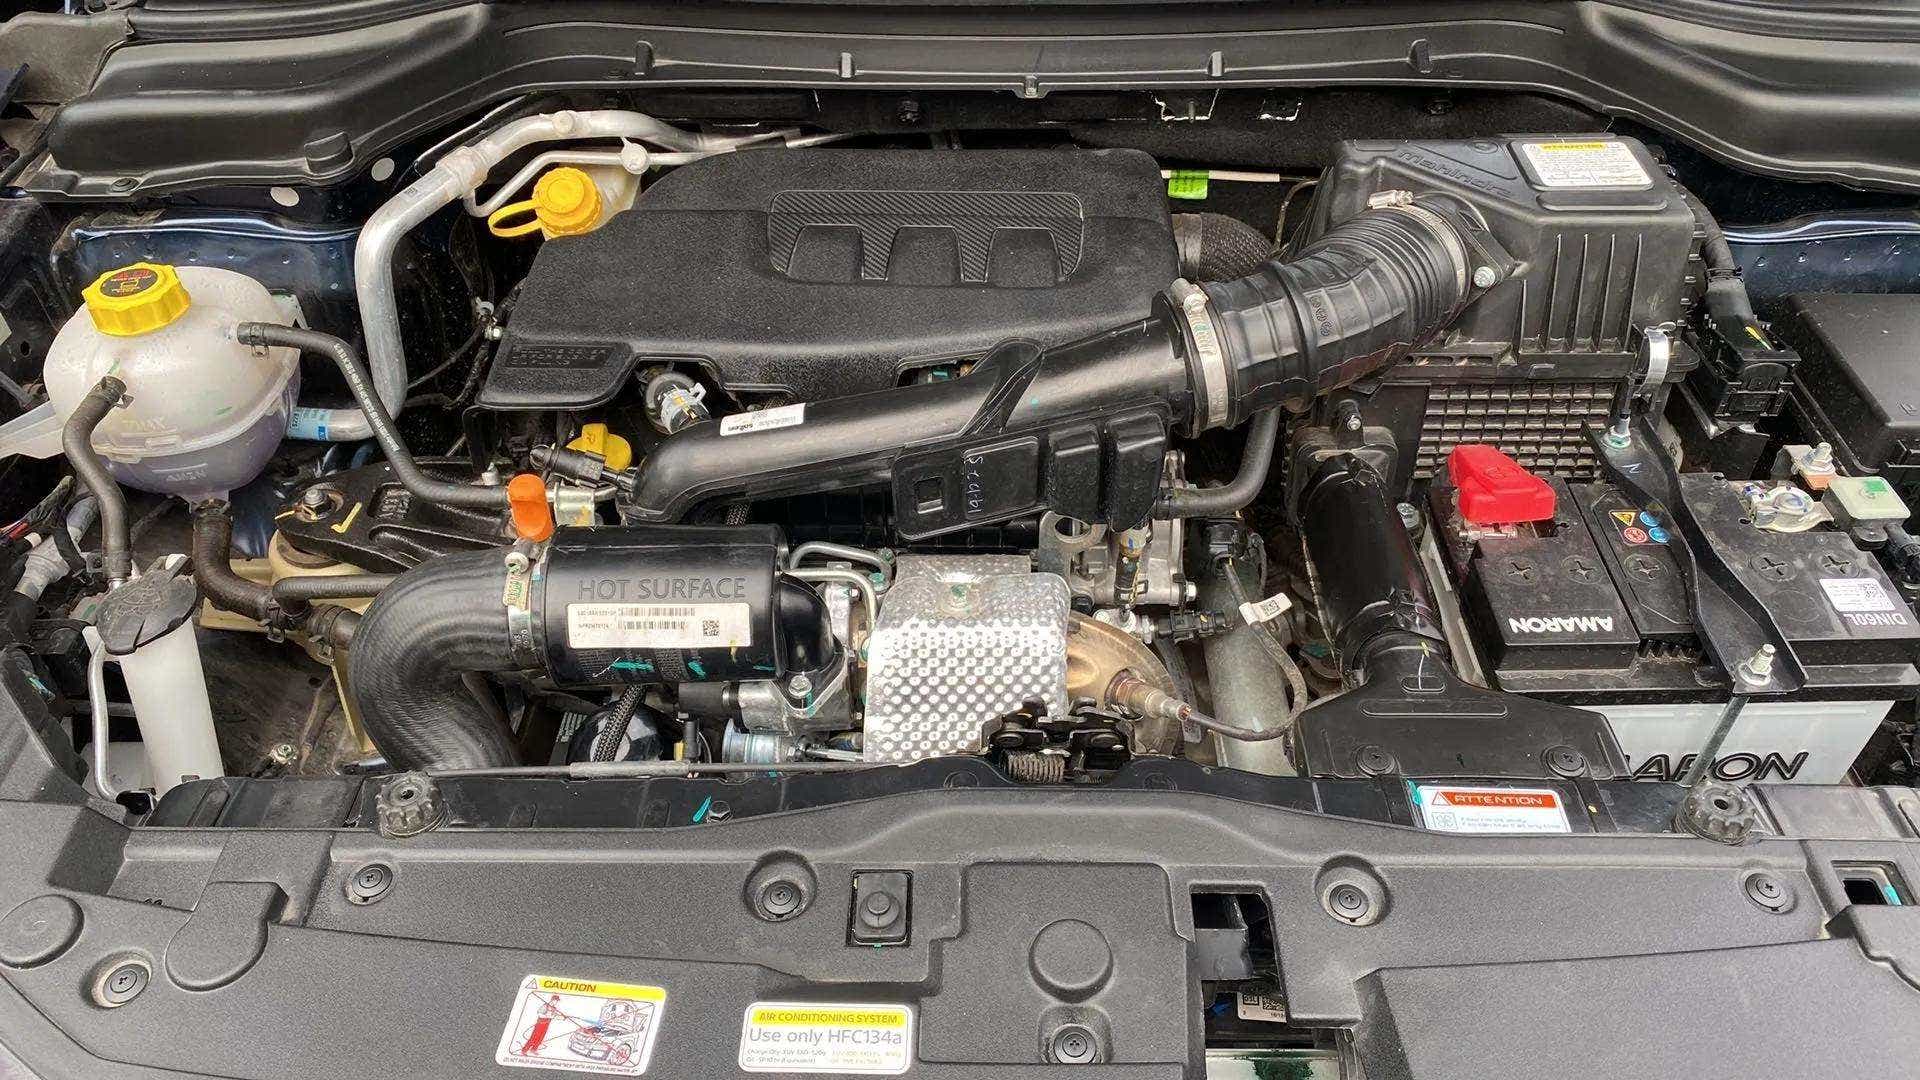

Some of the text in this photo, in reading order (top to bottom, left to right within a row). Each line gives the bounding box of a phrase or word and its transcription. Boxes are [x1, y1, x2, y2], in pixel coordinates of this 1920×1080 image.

[578, 577, 747, 601] HOT SURFACE
[1508, 616, 1613, 633] AMARON
[1454, 794, 1543, 805] ATTENTION
[543, 980, 598, 993] CAUTION
[759, 1012, 898, 1024] AIR CONDITIONING SYSTEM
[750, 1028, 902, 1046] Use only HFC134a
